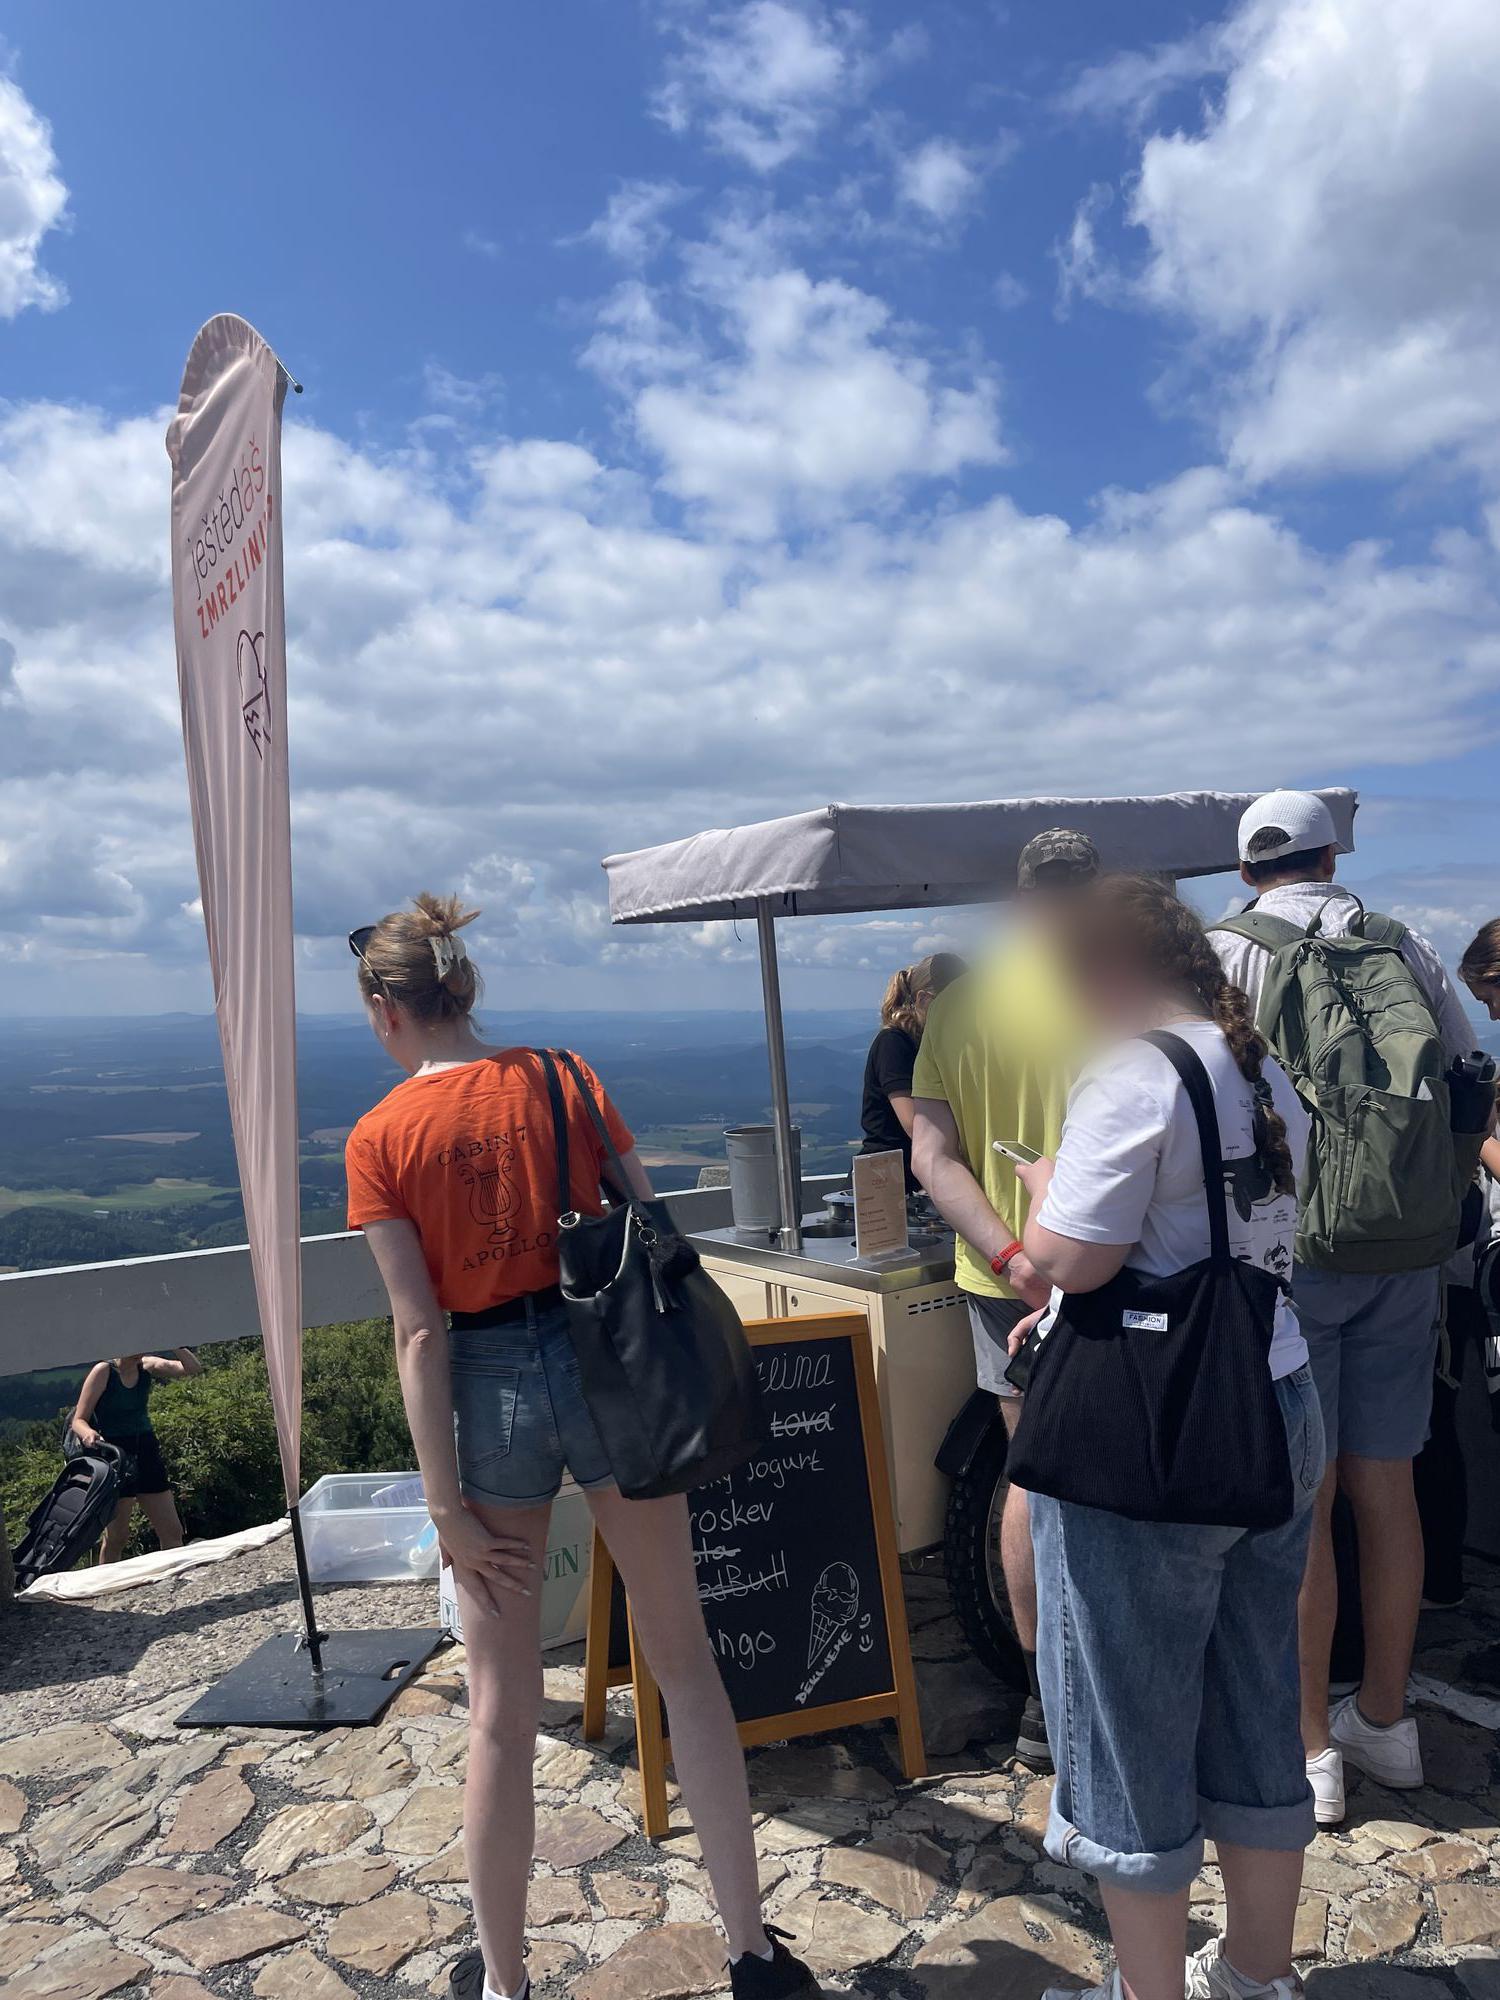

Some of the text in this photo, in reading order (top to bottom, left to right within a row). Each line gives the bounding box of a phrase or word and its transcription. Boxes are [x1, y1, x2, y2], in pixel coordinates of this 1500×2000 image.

[438, 1126, 527, 1167] CABIN 7
[462, 1232, 550, 1271] APOLLO
[689, 1498, 775, 1533] roskev
